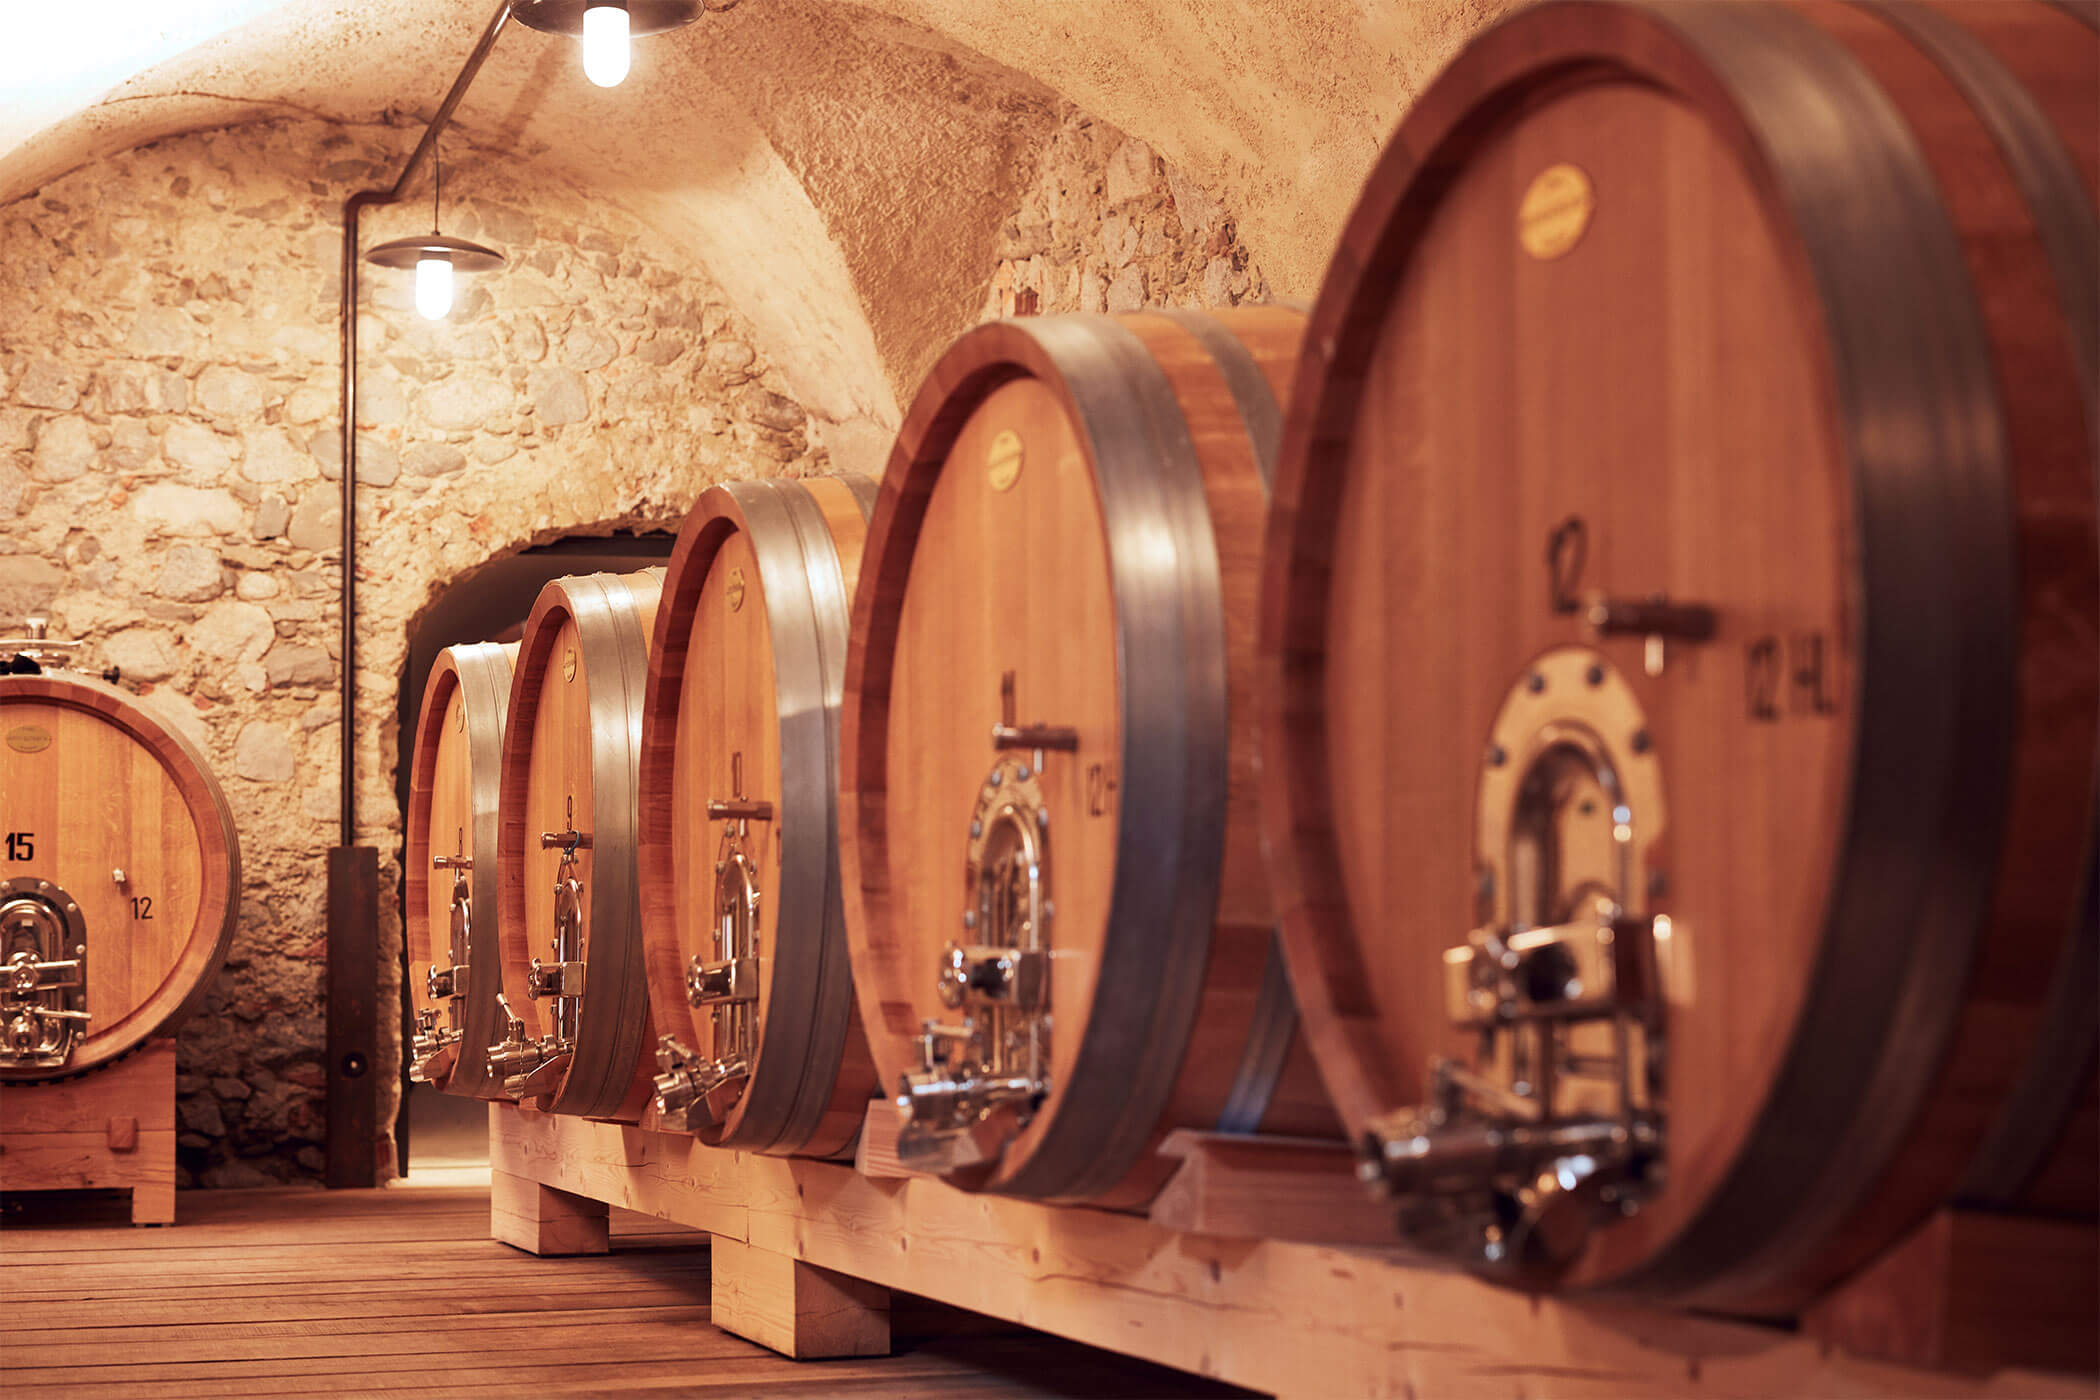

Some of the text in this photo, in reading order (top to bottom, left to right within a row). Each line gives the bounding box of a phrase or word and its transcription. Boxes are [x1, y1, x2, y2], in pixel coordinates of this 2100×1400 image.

[566, 794, 573, 830] 9
[5, 832, 35, 861] 15
[130, 896, 153, 920] 12
